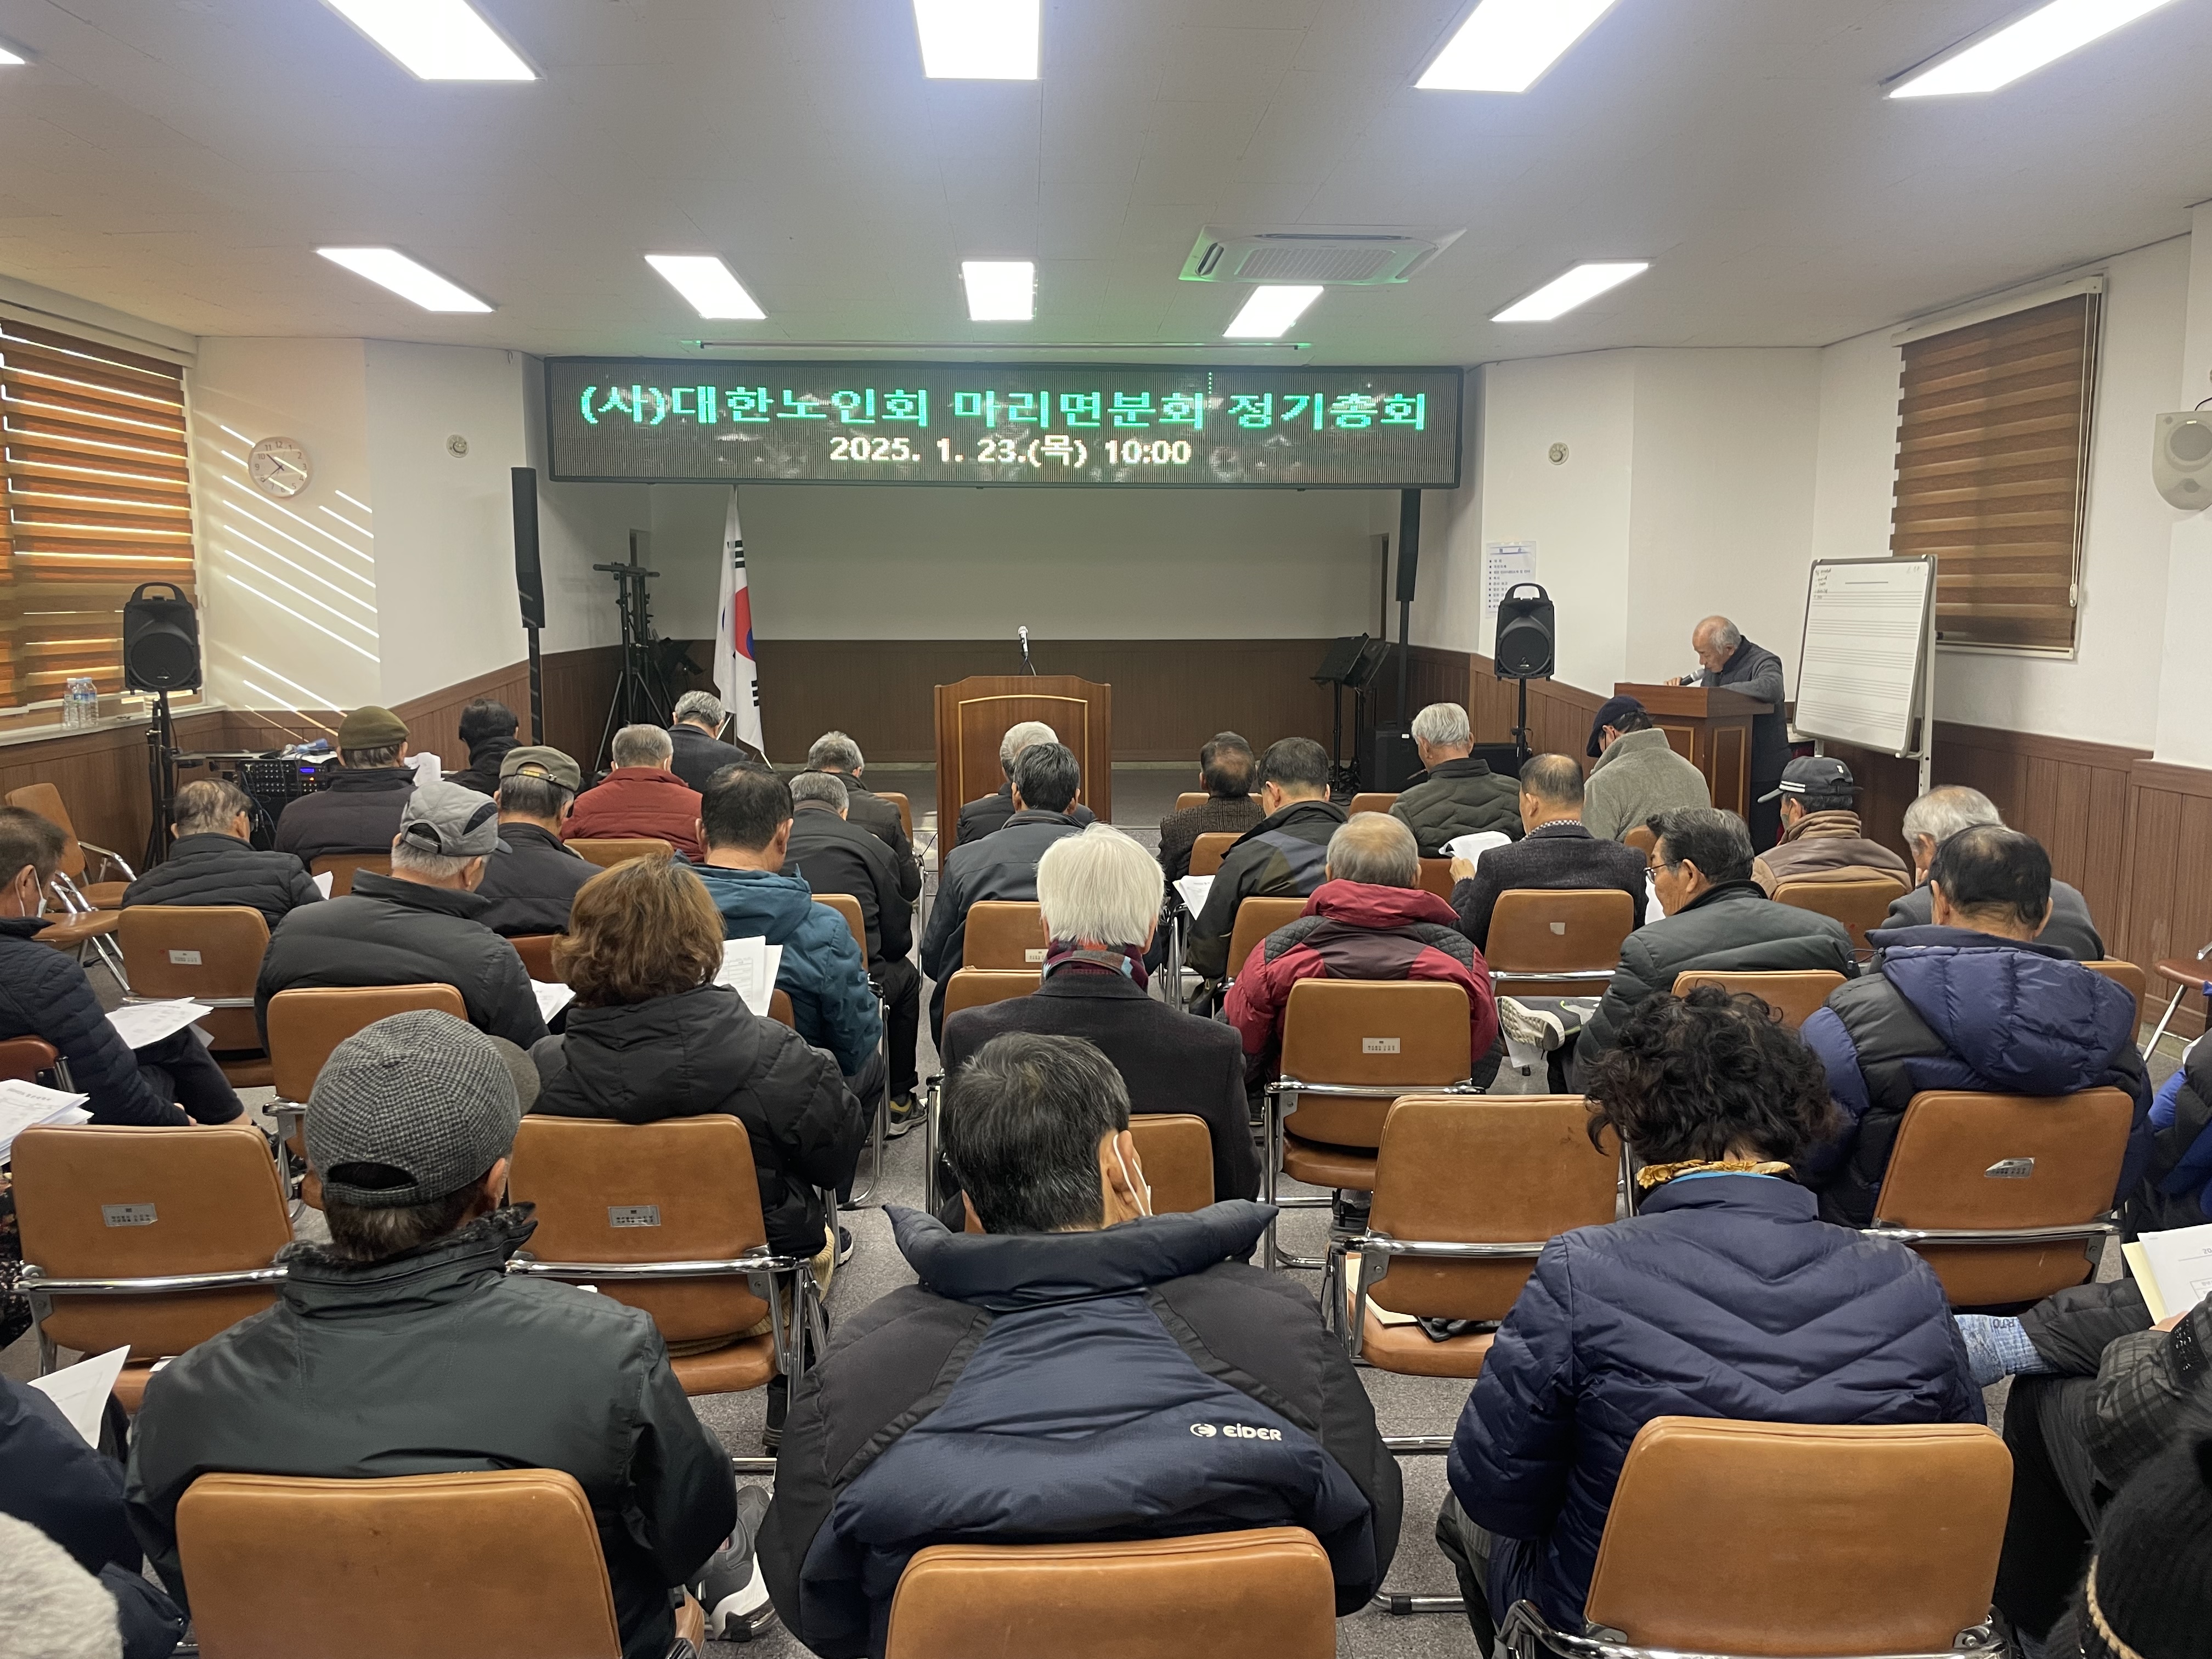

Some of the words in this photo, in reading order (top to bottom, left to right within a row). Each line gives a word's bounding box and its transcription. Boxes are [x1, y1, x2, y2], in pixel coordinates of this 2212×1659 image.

[580, 385, 928, 427] (사)대한노인회
[953, 390, 1203, 430] 마리면분회
[1228, 392, 1425, 431] 정기총회
[830, 437, 921, 462] 2025.
[937, 437, 964, 462] 1.
[977, 435, 1087, 467] 23.(목)
[1104, 439, 1192, 465] 10:00
